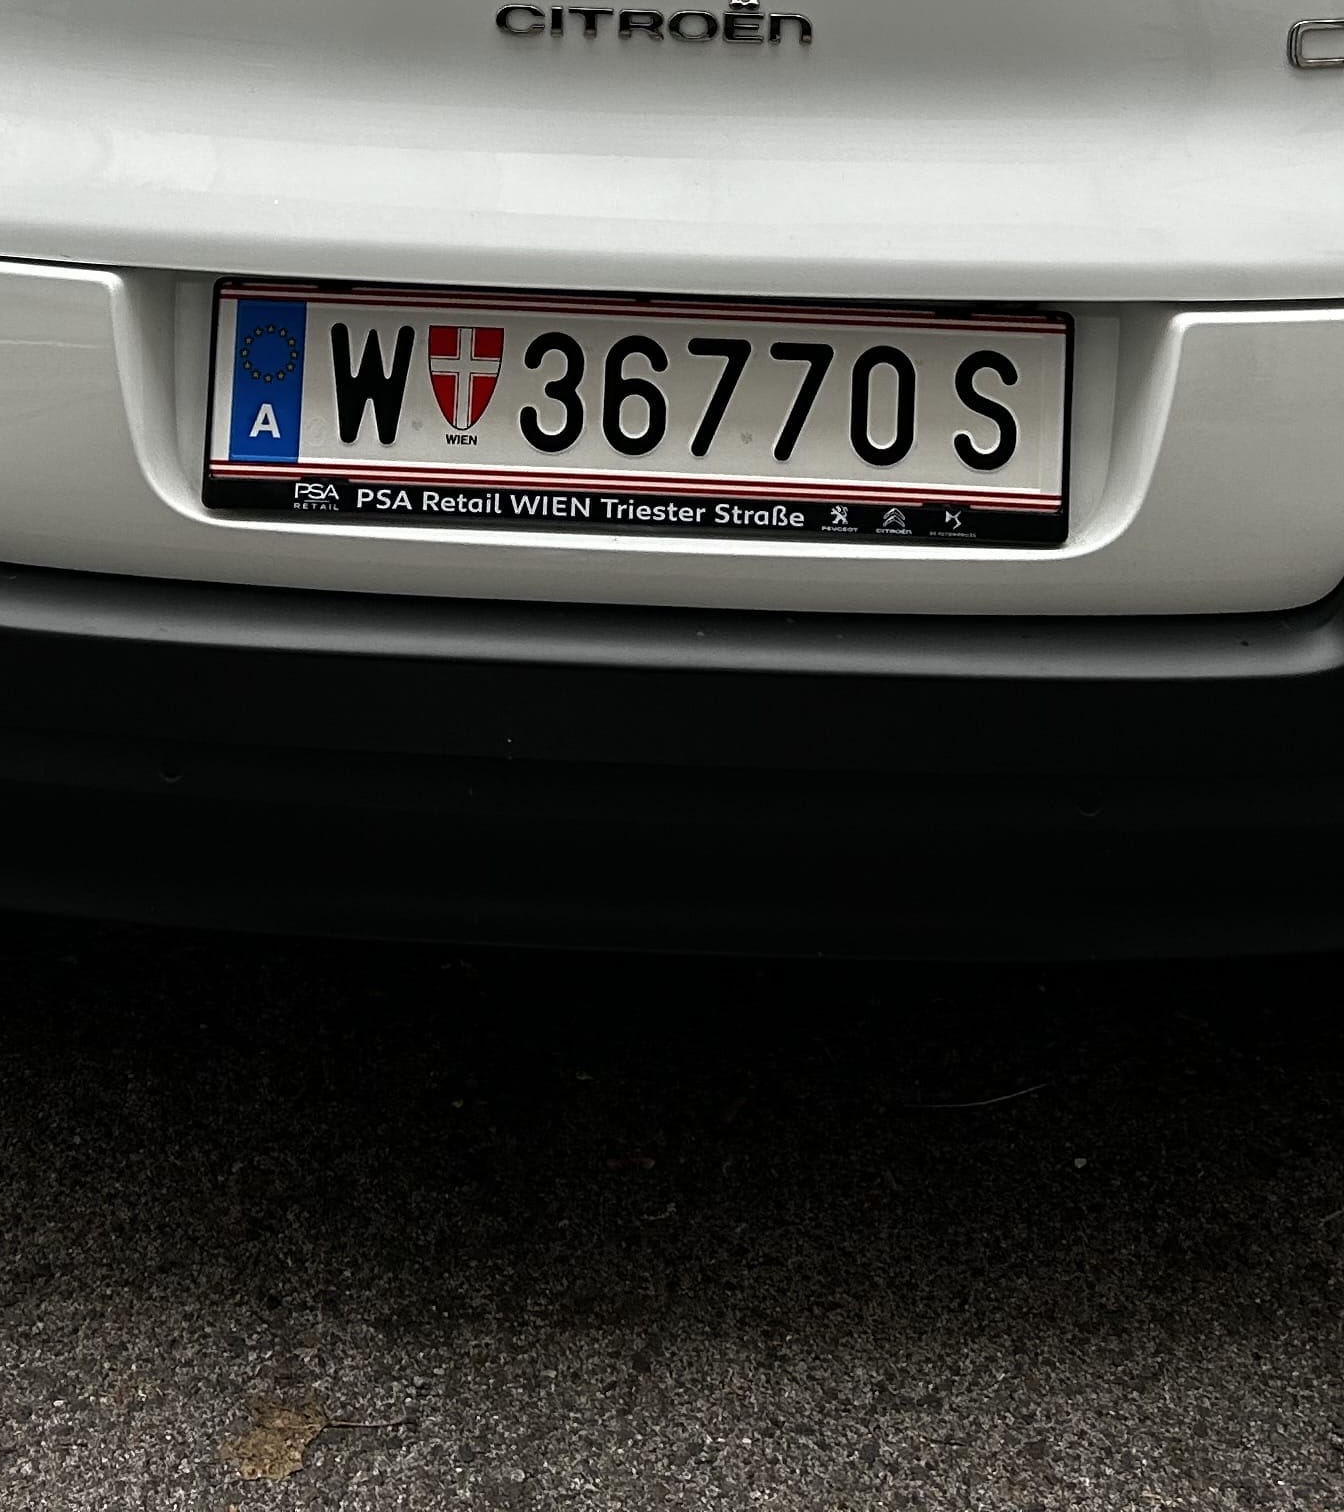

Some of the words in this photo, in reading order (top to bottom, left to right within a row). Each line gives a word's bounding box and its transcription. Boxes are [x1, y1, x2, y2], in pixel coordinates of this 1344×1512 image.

[330, 322, 416, 446] W
[519, 331, 916, 468] 36770
[953, 349, 1019, 472] S
[249, 403, 281, 439] A
[445, 434, 478, 446] WIEN
[294, 482, 340, 500] PSA
[293, 502, 340, 511] RETAIL
[357, 489, 413, 510] PSA
[422, 491, 502, 514] Retail
[510, 494, 591, 518] WIEN
[600, 498, 706, 522] Triester
[714, 503, 805, 527] Straße
